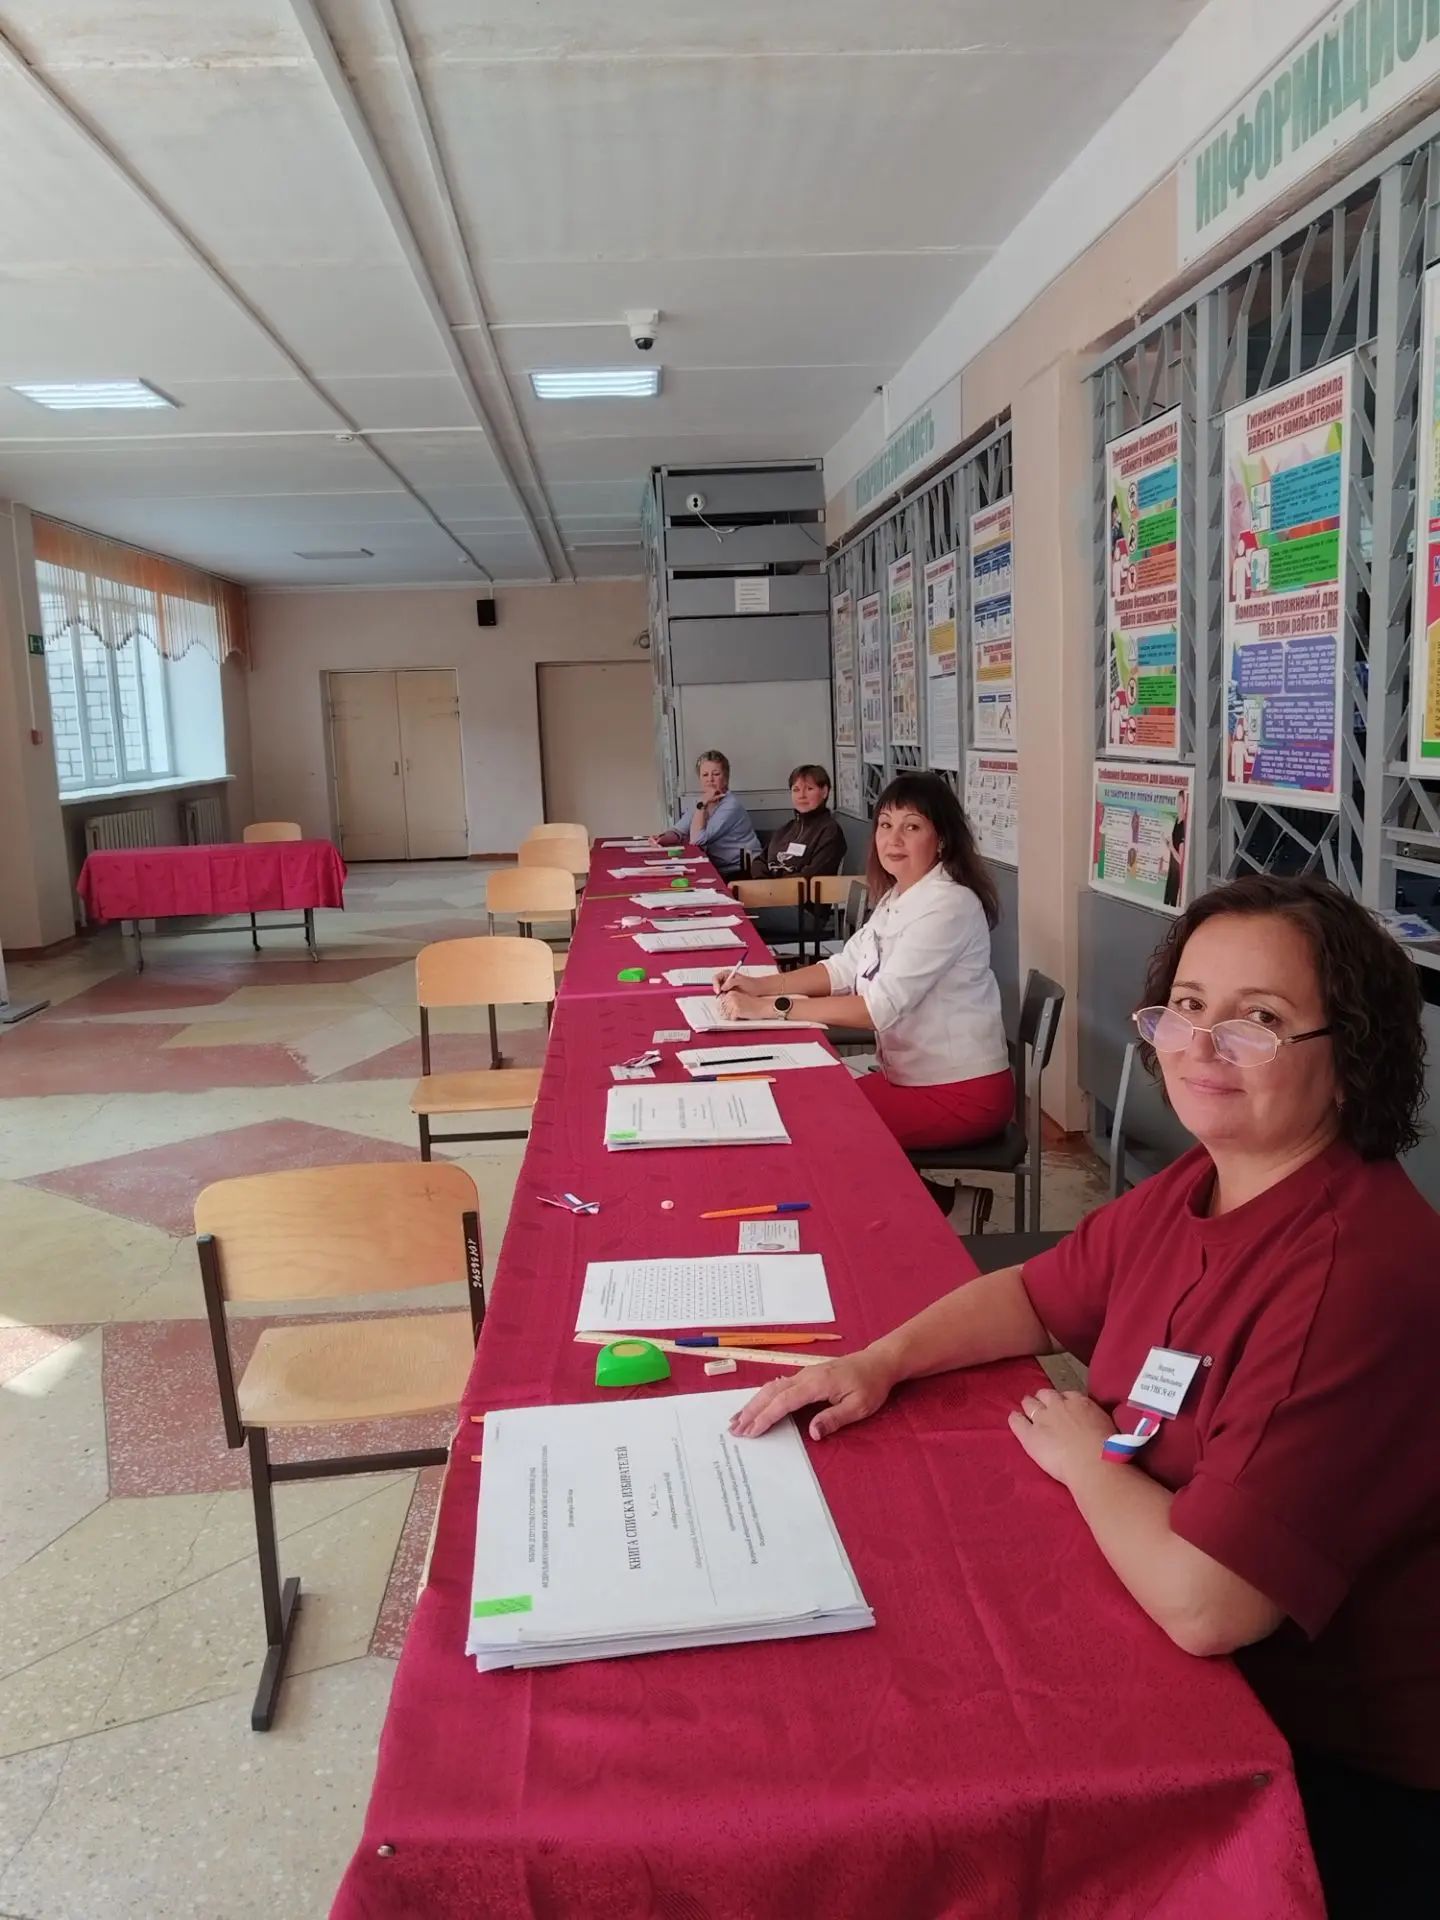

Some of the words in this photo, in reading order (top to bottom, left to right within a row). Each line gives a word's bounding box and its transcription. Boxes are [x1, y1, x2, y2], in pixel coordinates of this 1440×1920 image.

[1247, 393, 1304, 431] Гигиенические
[1306, 376, 1343, 405] правила
[1247, 426, 1275, 452] работы
[1283, 399, 1343, 437] компьютером
[1235, 602, 1271, 620] Комплекс
[1271, 591, 1321, 616] упражнений
[1322, 591, 1339, 609] для
[1258, 622, 1275, 637] глаз
[1276, 620, 1290, 636] при
[1291, 614, 1319, 634] работе
[1327, 609, 1338, 628] ПК
[616, 1446, 633, 1498] ИЗБИРАТЕЛЕЙ
[622, 1498, 638, 1538] СПИСКА
[626, 1538, 642, 1570] КНИГА
